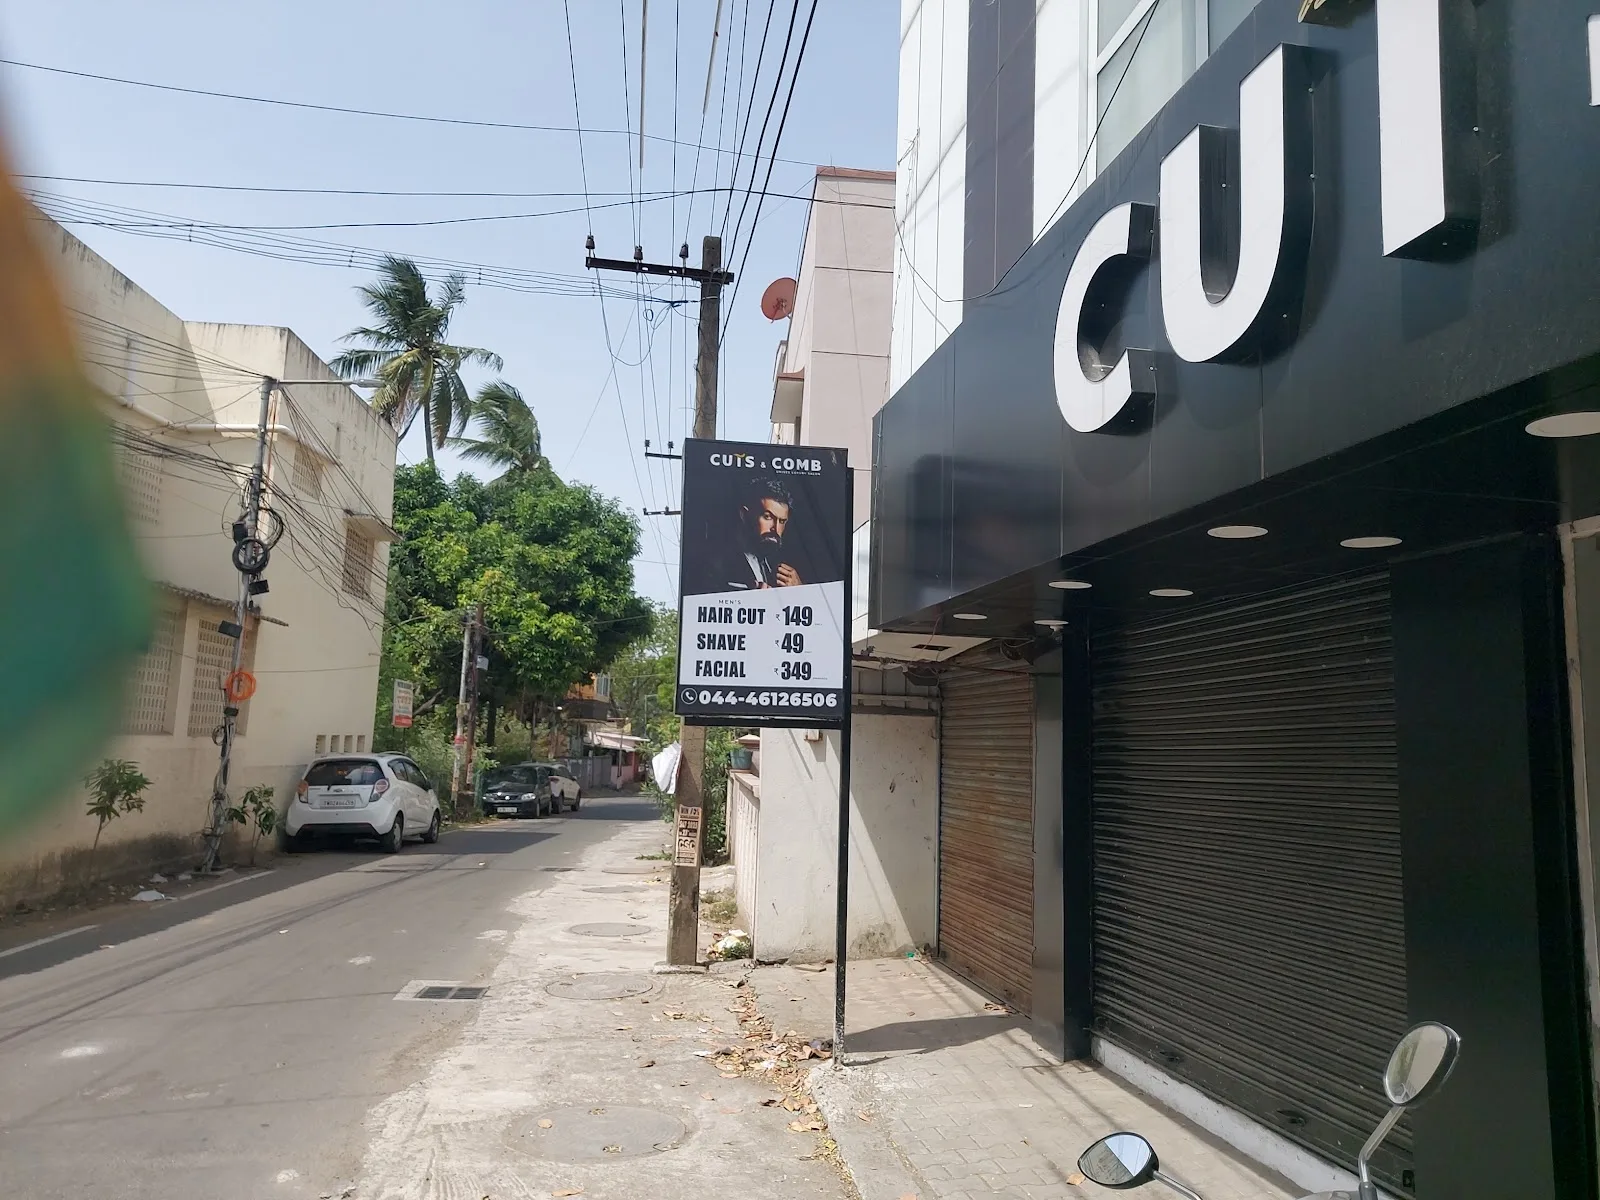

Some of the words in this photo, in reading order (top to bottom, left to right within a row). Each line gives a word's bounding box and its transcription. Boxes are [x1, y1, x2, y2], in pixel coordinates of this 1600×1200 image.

[710, 452, 755, 468] CUTS
[771, 457, 822, 472] COMB
[698, 606, 733, 624] HAIR
[737, 607, 766, 625] CUT
[697, 633, 746, 651] SHAVE
[695, 660, 746, 678] FACIAL
[698, 690, 838, 708] 044-46126506
